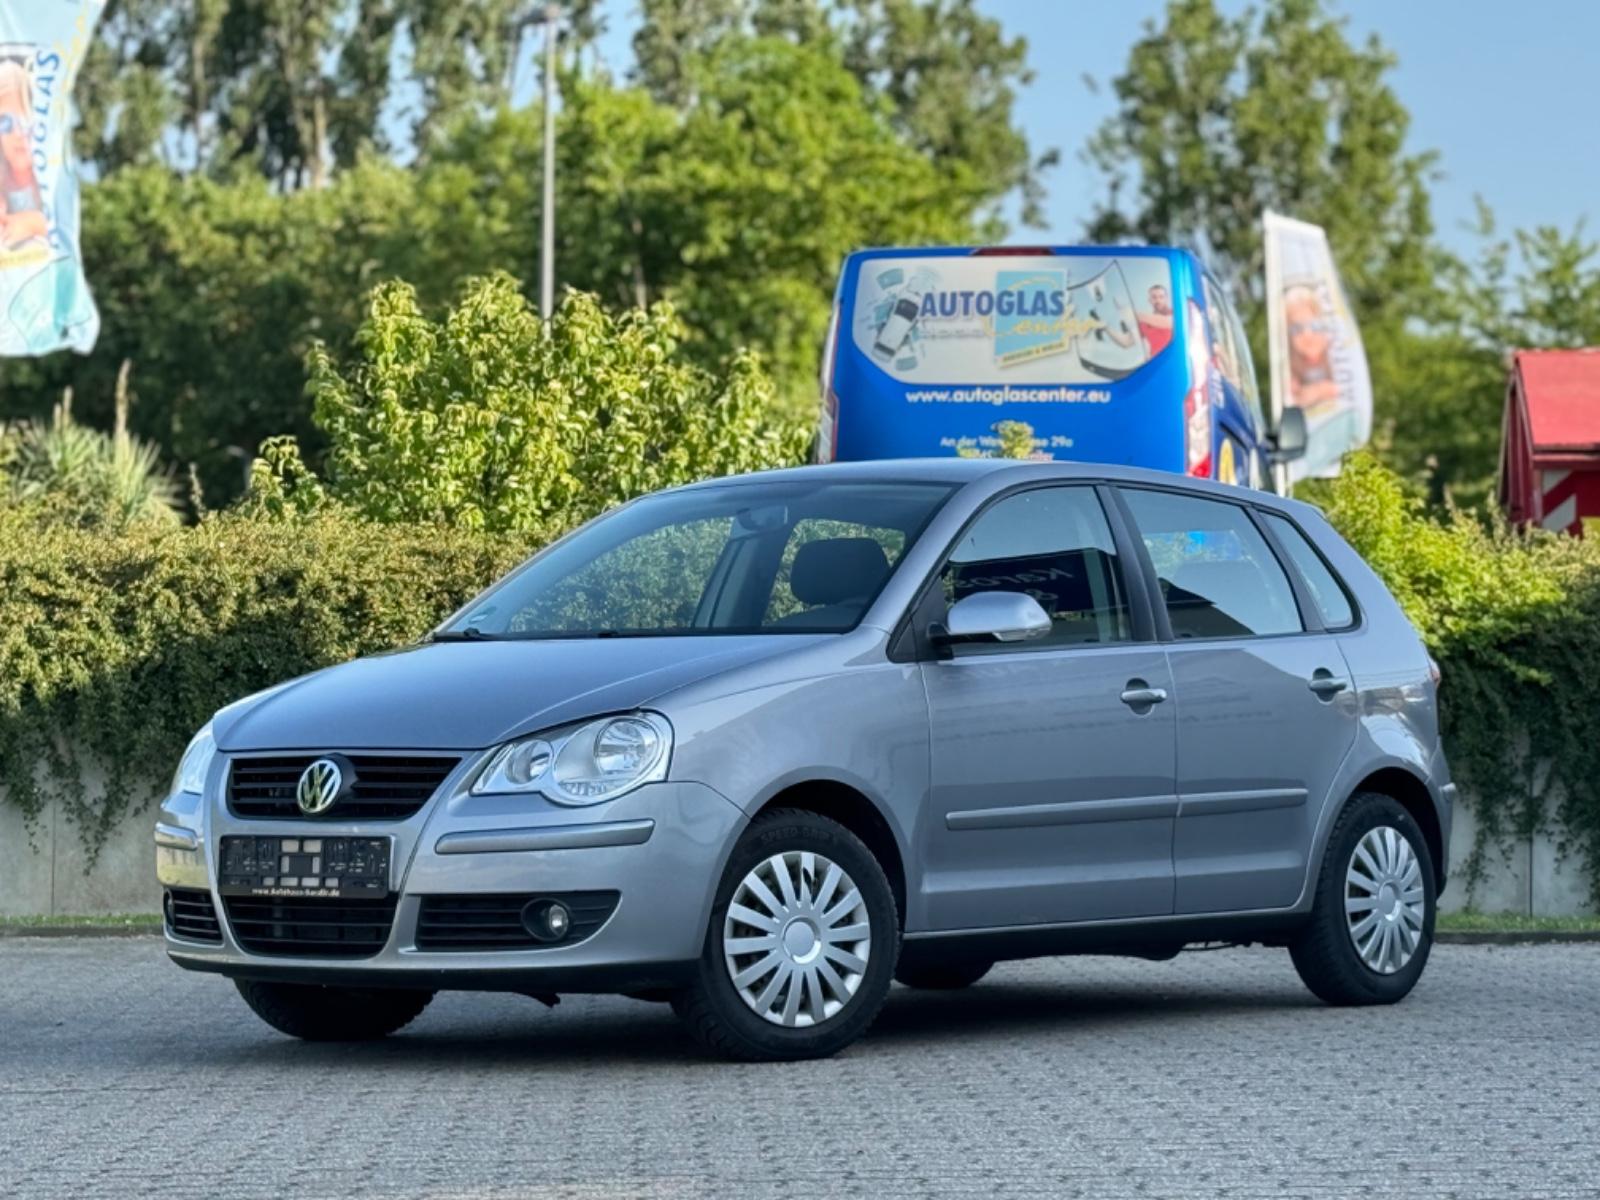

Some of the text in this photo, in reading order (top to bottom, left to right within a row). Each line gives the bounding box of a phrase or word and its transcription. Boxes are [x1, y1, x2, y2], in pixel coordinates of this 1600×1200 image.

[920, 290, 1065, 317] AUTOGLAS
[905, 386, 1111, 405] www.autoglascenter.eu
[297, 759, 342, 813] VW
